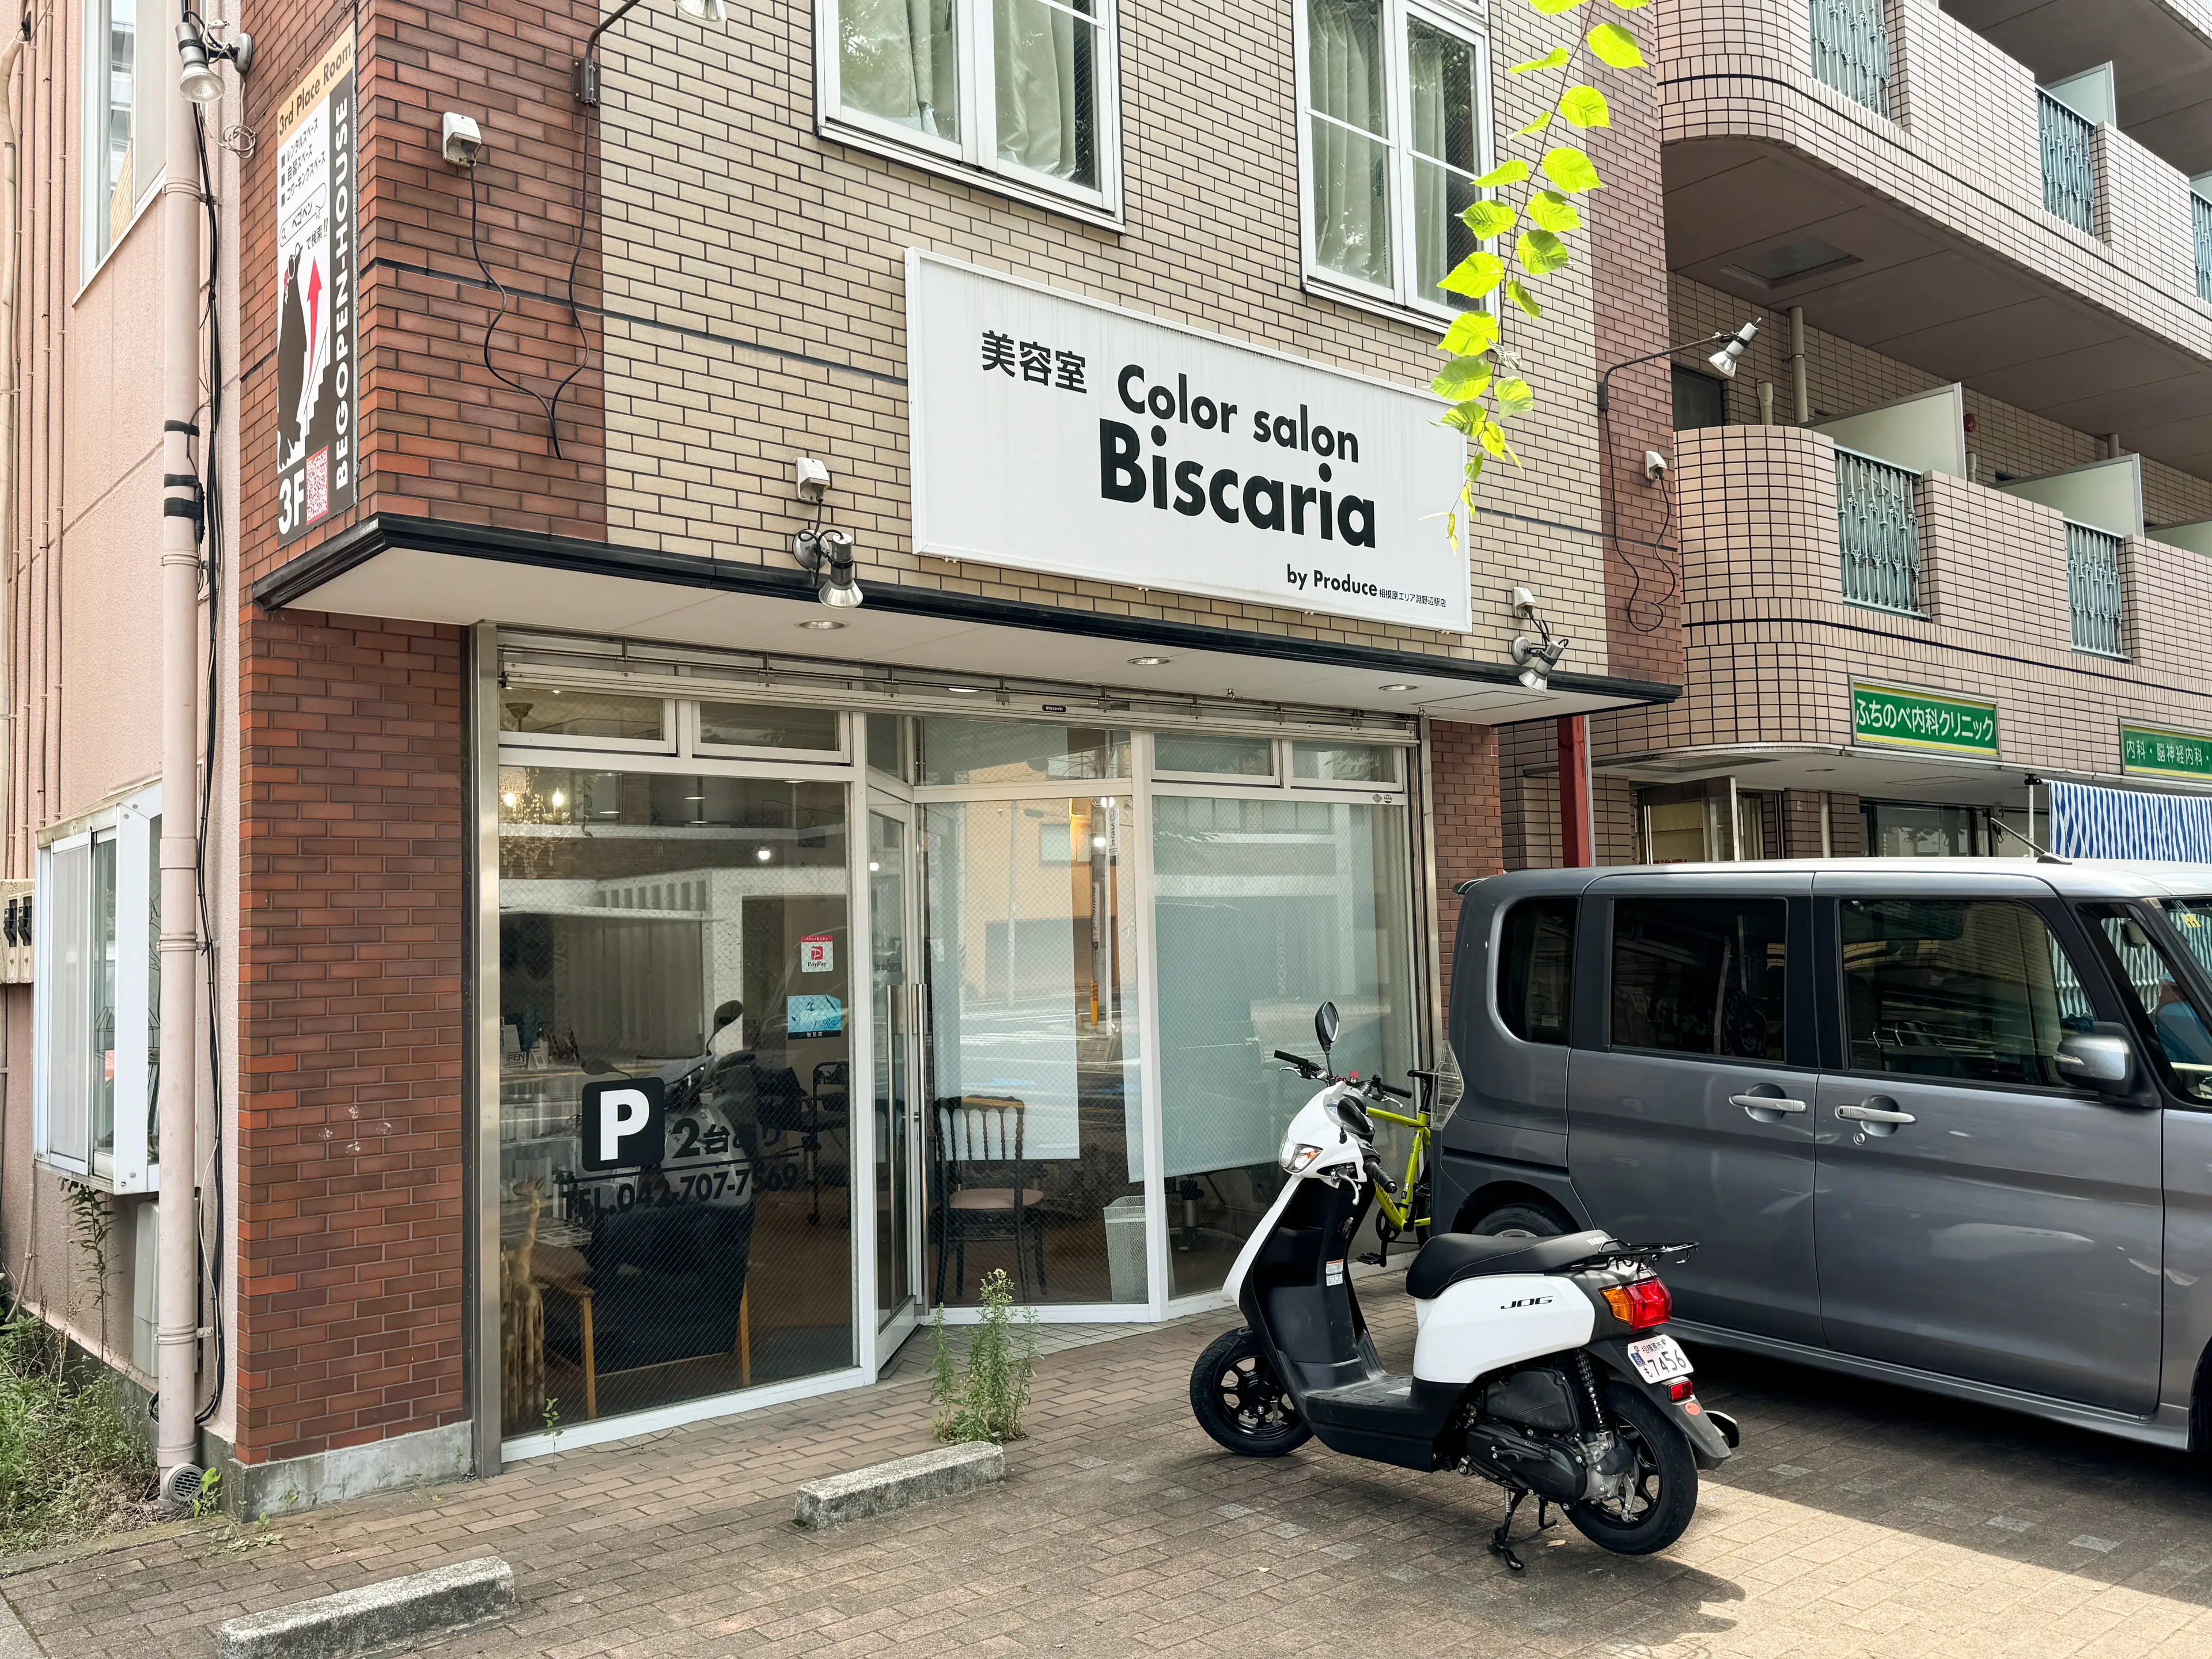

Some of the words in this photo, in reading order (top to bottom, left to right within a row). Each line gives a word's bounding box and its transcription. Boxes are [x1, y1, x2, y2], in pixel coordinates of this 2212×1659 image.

[279, 100, 294, 136] 3rd
[297, 79, 320, 116] Place
[324, 43, 351, 86] Room
[335, 97, 348, 490] BEGOPEN-HOUSE
[982, 330, 1087, 393] 美容室
[1118, 364, 1237, 433] Color
[1254, 403, 1358, 463] salon
[279, 468, 304, 535] 3F
[1100, 418, 1376, 548] Biscaria
[1287, 563, 1308, 590] by
[1314, 570, 1377, 597] Produce
[1856, 698, 1993, 741] ふちのべ内科クリニック
[600, 1089, 650, 1161] P
[1501, 1296, 1553, 1309] JOG
[1641, 1342, 1664, 1354] 相模原市
[1647, 1349, 1687, 1376] 7456
